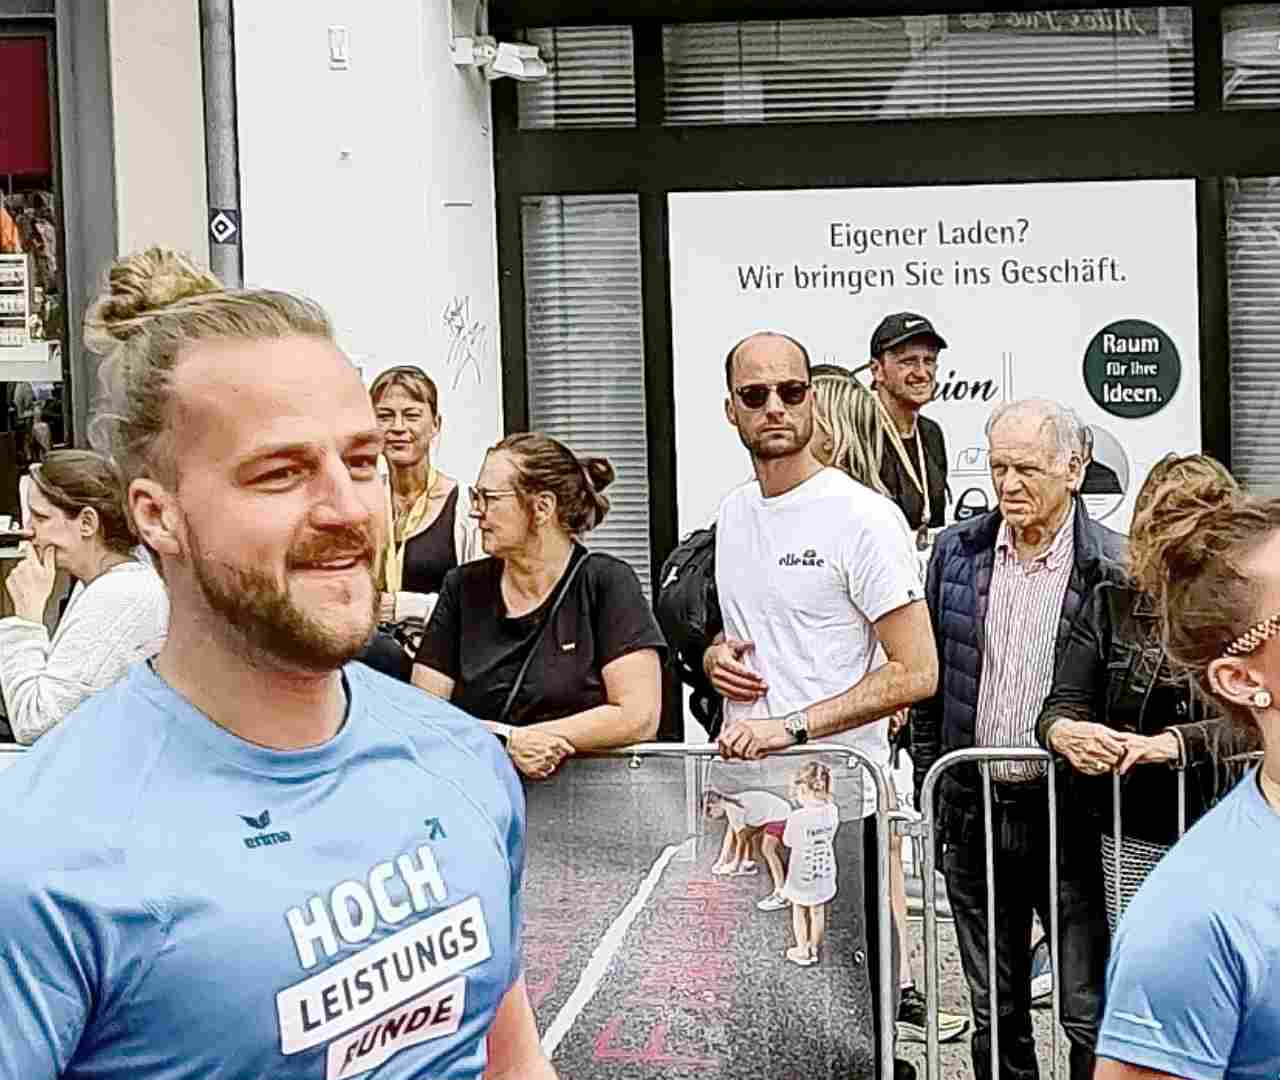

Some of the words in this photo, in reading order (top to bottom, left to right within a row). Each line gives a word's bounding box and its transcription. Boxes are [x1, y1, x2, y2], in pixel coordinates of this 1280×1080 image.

[830, 222, 927, 253] Eigener
[938, 219, 1029, 246] Laden?
[738, 264, 784, 290] Wir
[795, 261, 895, 294] bringen
[906, 261, 944, 287] Sie
[954, 260, 991, 285] ins
[1001, 257, 1127, 285] Geschäft.
[1104, 334, 1159, 353] Raum
[1106, 361, 1128, 376] für
[1131, 360, 1158, 376] Ihre
[931, 370, 999, 402] ion
[1104, 382, 1162, 402] Ideen.
[285, 845, 448, 971] HOCH
[300, 917, 478, 1032] LEISTUNGS
